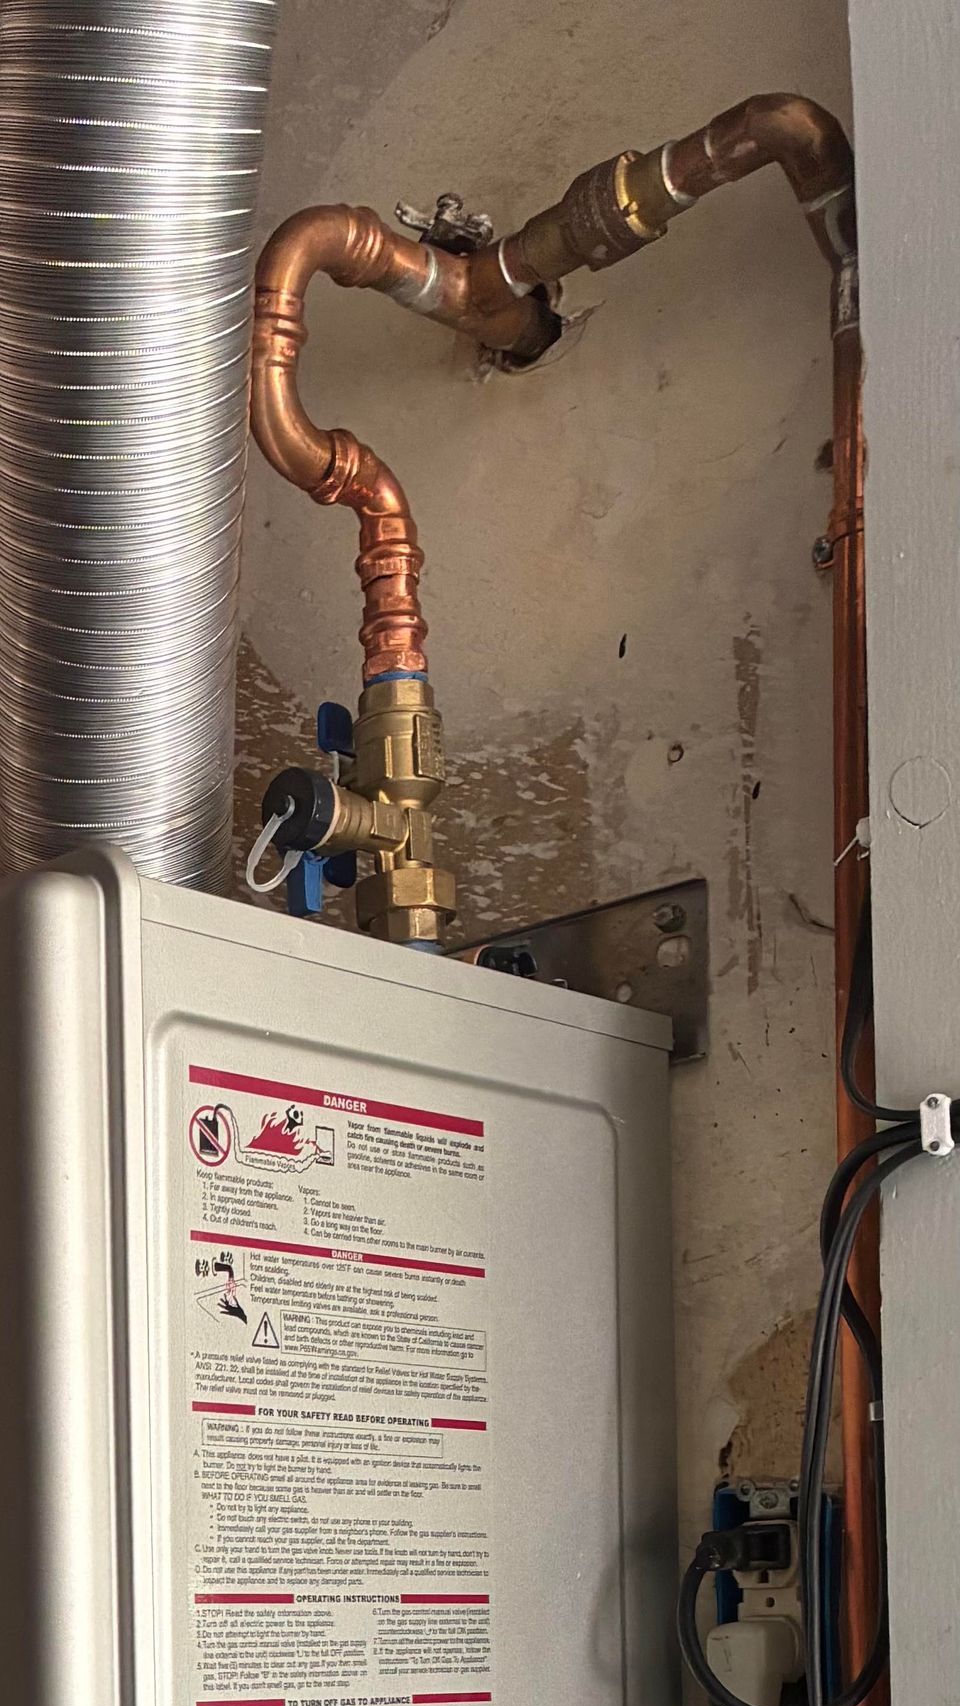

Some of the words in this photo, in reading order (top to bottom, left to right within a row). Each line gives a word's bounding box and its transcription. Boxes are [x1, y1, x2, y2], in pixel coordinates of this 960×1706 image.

[323, 1094, 366, 1113] DANGER
[331, 1250, 363, 1262] DANGER
[258, 1407, 273, 1416] FOR
[277, 1408, 298, 1418] YOUR
[300, 1410, 329, 1420] SAFETY
[333, 1412, 353, 1422] READ
[356, 1414, 384, 1424] BEFORE
[387, 1416, 428, 1427] OPERATING
[296, 1594, 340, 1602] OPERATING
[301, 1699, 321, 1706] TURN
[324, 1698, 337, 1706] OFF
[340, 1698, 355, 1706] GAS
[358, 1697, 367, 1705] TO
[370, 1696, 410, 1705] APPLIANCE
